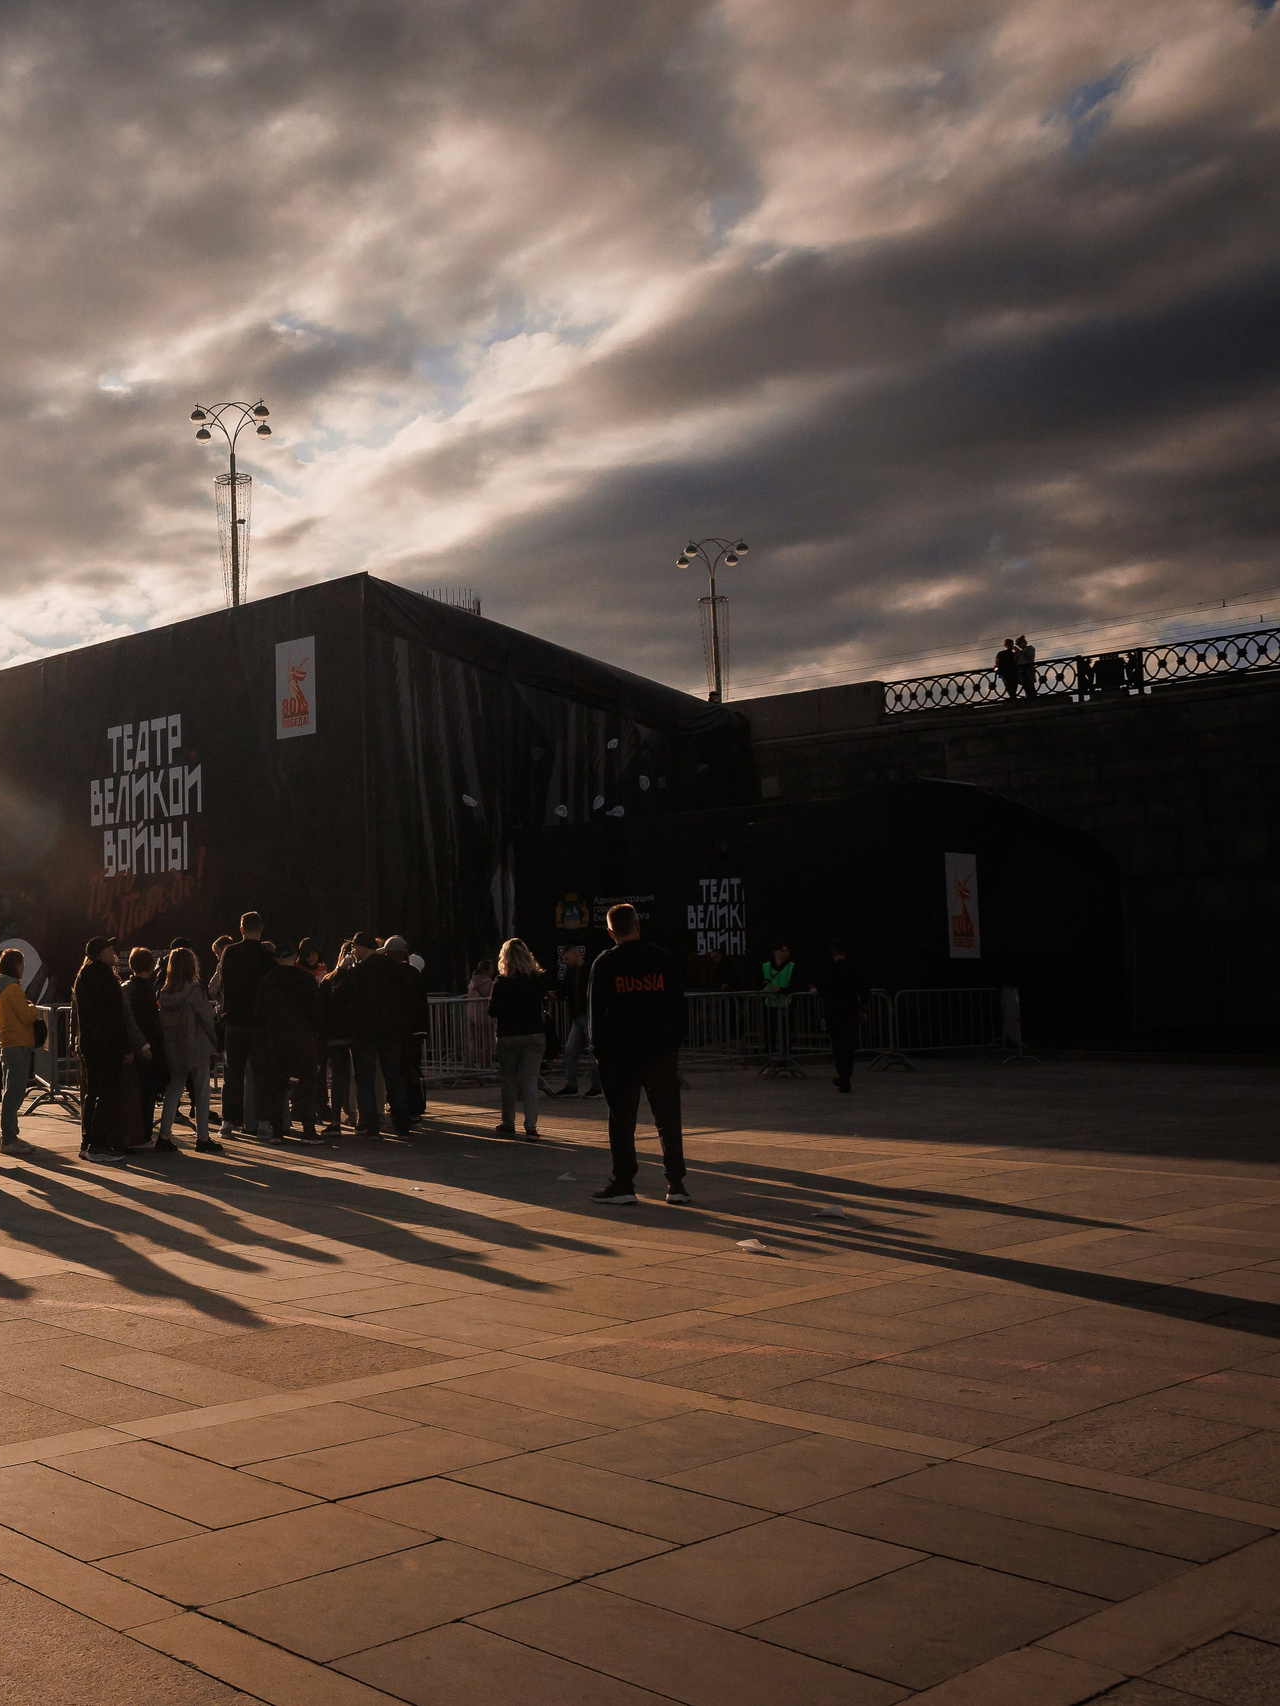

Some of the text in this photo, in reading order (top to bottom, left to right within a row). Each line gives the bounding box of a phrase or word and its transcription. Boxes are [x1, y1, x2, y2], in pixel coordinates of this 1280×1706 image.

[282, 698, 297, 717] 80
[282, 715, 310, 729] ПОБЕДА!
[107, 713, 182, 774] ТЕАТР
[103, 819, 188, 878] ВОЙНЫ
[615, 972, 666, 994] RUSSIA
